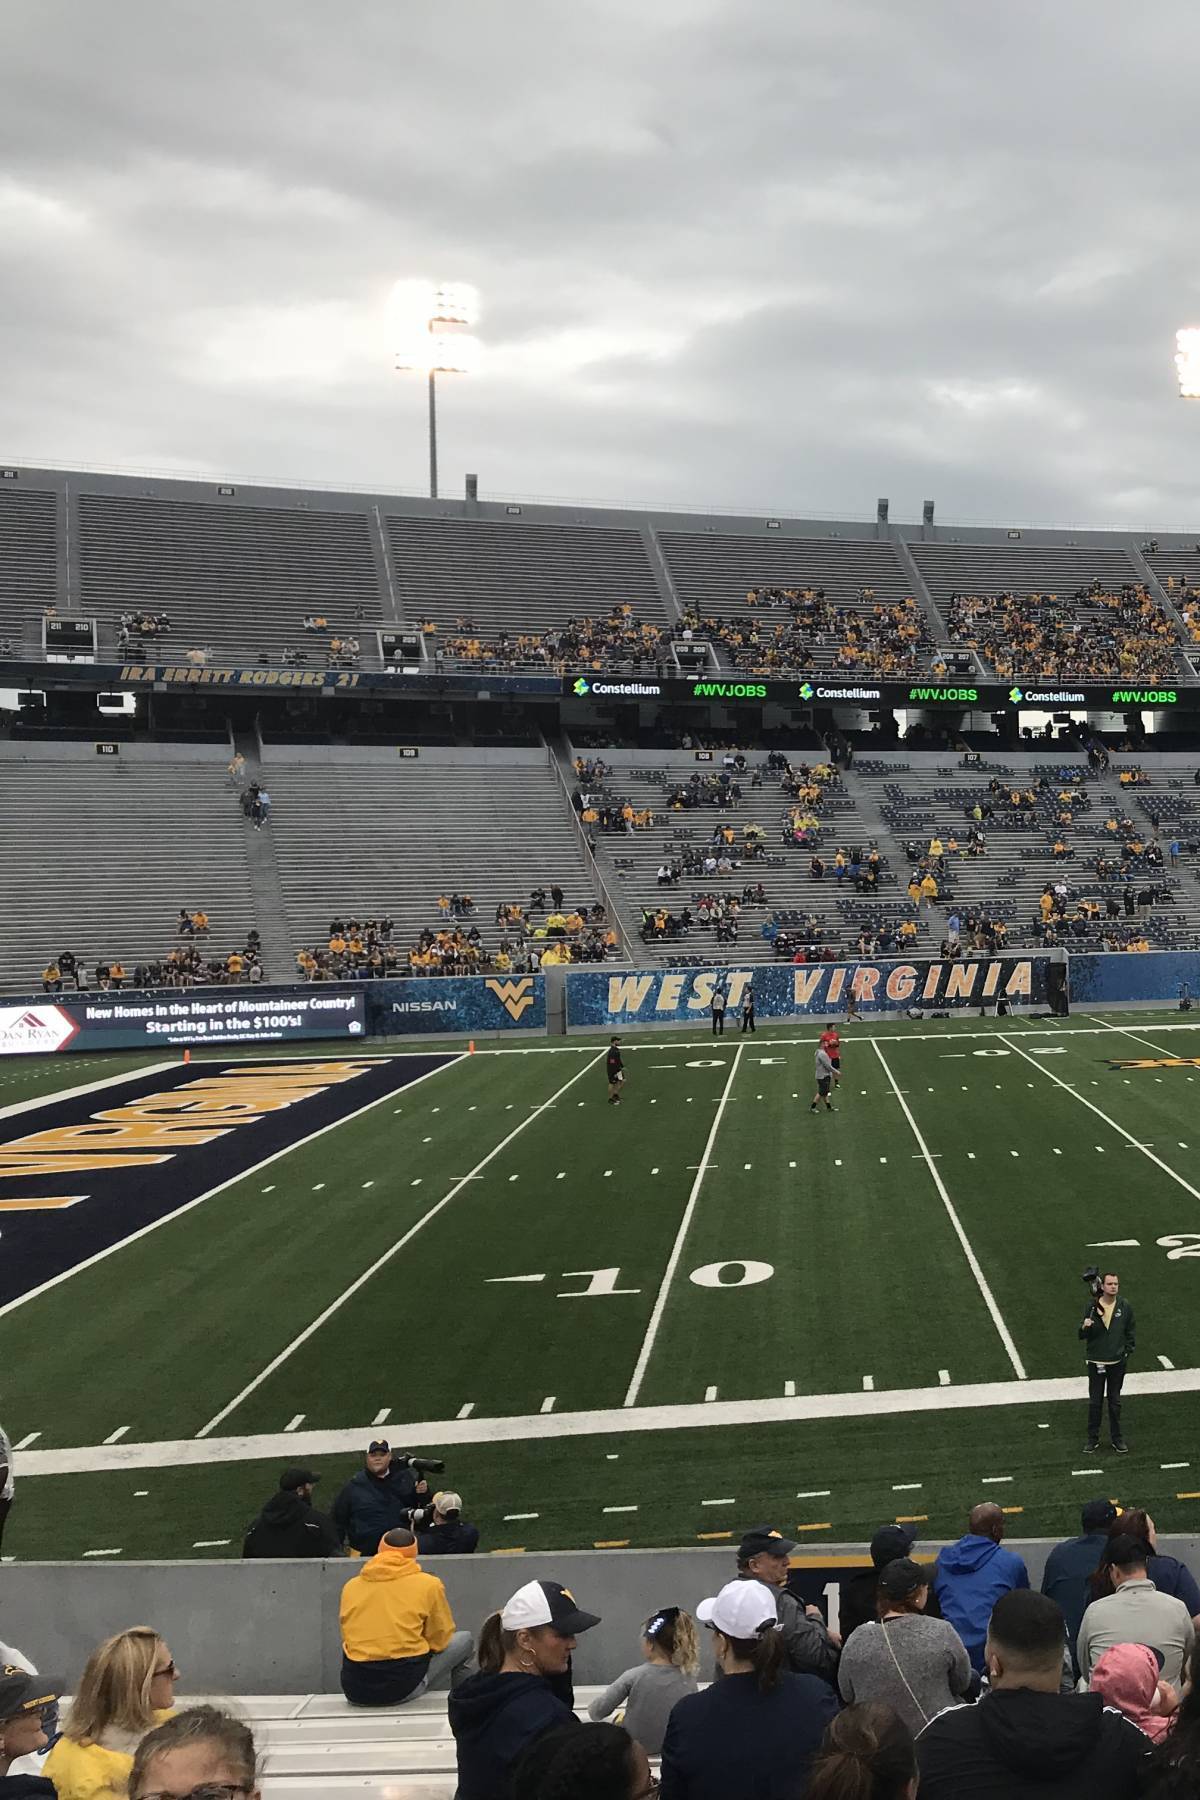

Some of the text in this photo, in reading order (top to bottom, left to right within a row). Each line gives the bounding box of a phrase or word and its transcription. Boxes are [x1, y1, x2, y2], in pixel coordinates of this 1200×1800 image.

[75, 623, 88, 631] 210
[120, 666, 156, 680] IRA
[238, 670, 326, 686] RODGERS
[336, 673, 360, 686] 21
[592, 683, 660, 695] Constellium
[694, 684, 766, 697] #WVJOBS
[816, 688, 880, 699] Constellium
[909, 689, 977, 700] #WVJOBS
[1025, 692, 1084, 702] Constellium
[1112, 691, 1176, 703] #WVJOBS
[608, 961, 1032, 1012] WEST VIRGINIA
[86, 996, 356, 1019] New Homes in the Heart of Mountaineer Country!
[392, 1000, 457, 1012] NISSAN
[146, 1019, 207, 1033] Starting
[210, 1018, 223, 1030] in
[226, 1018, 251, 1029] the
[556, 1260, 774, 1298] 10
